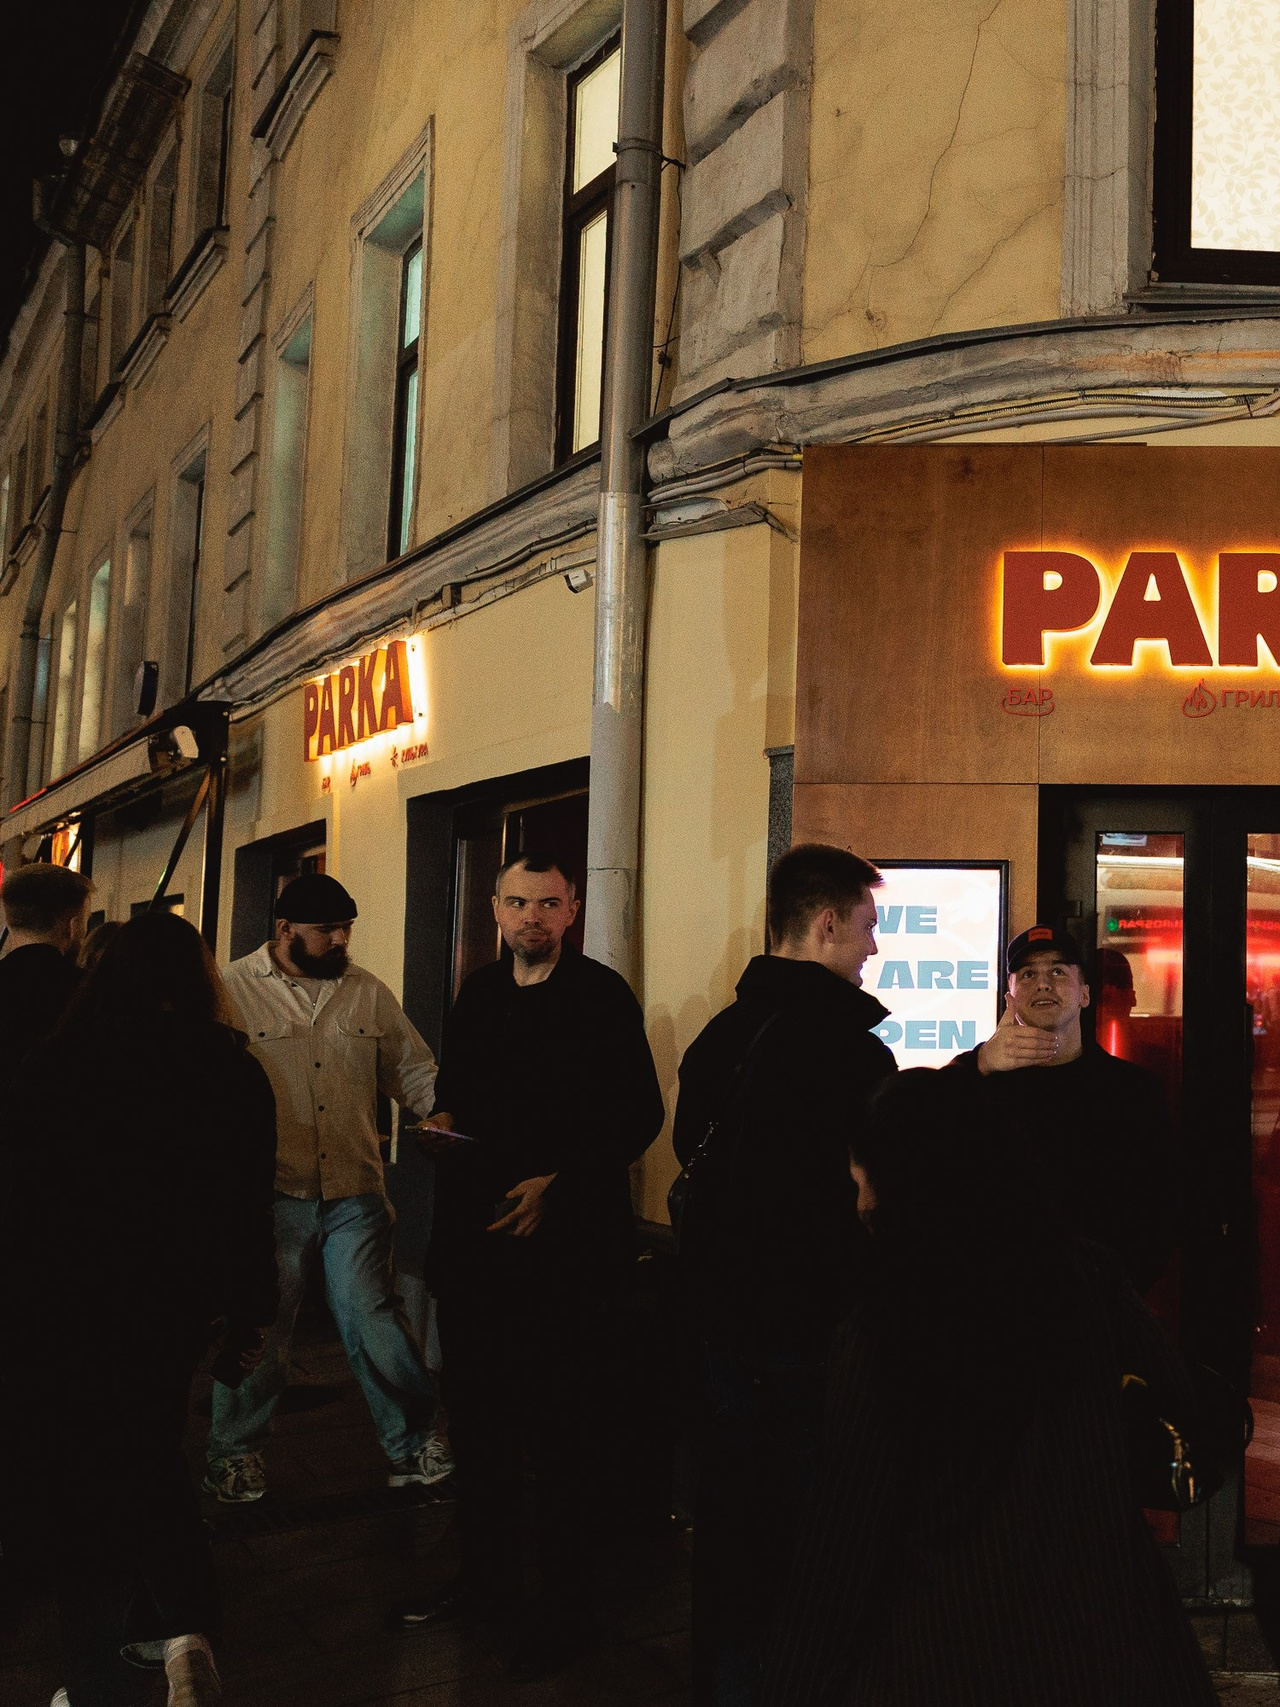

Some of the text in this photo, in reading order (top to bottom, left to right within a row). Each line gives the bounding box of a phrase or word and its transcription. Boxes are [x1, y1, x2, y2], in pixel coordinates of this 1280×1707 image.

[304, 640, 413, 762] PARKA
[1006, 686, 1053, 706] БАР
[876, 960, 989, 990] ARE
[868, 1020, 977, 1050] PEN
